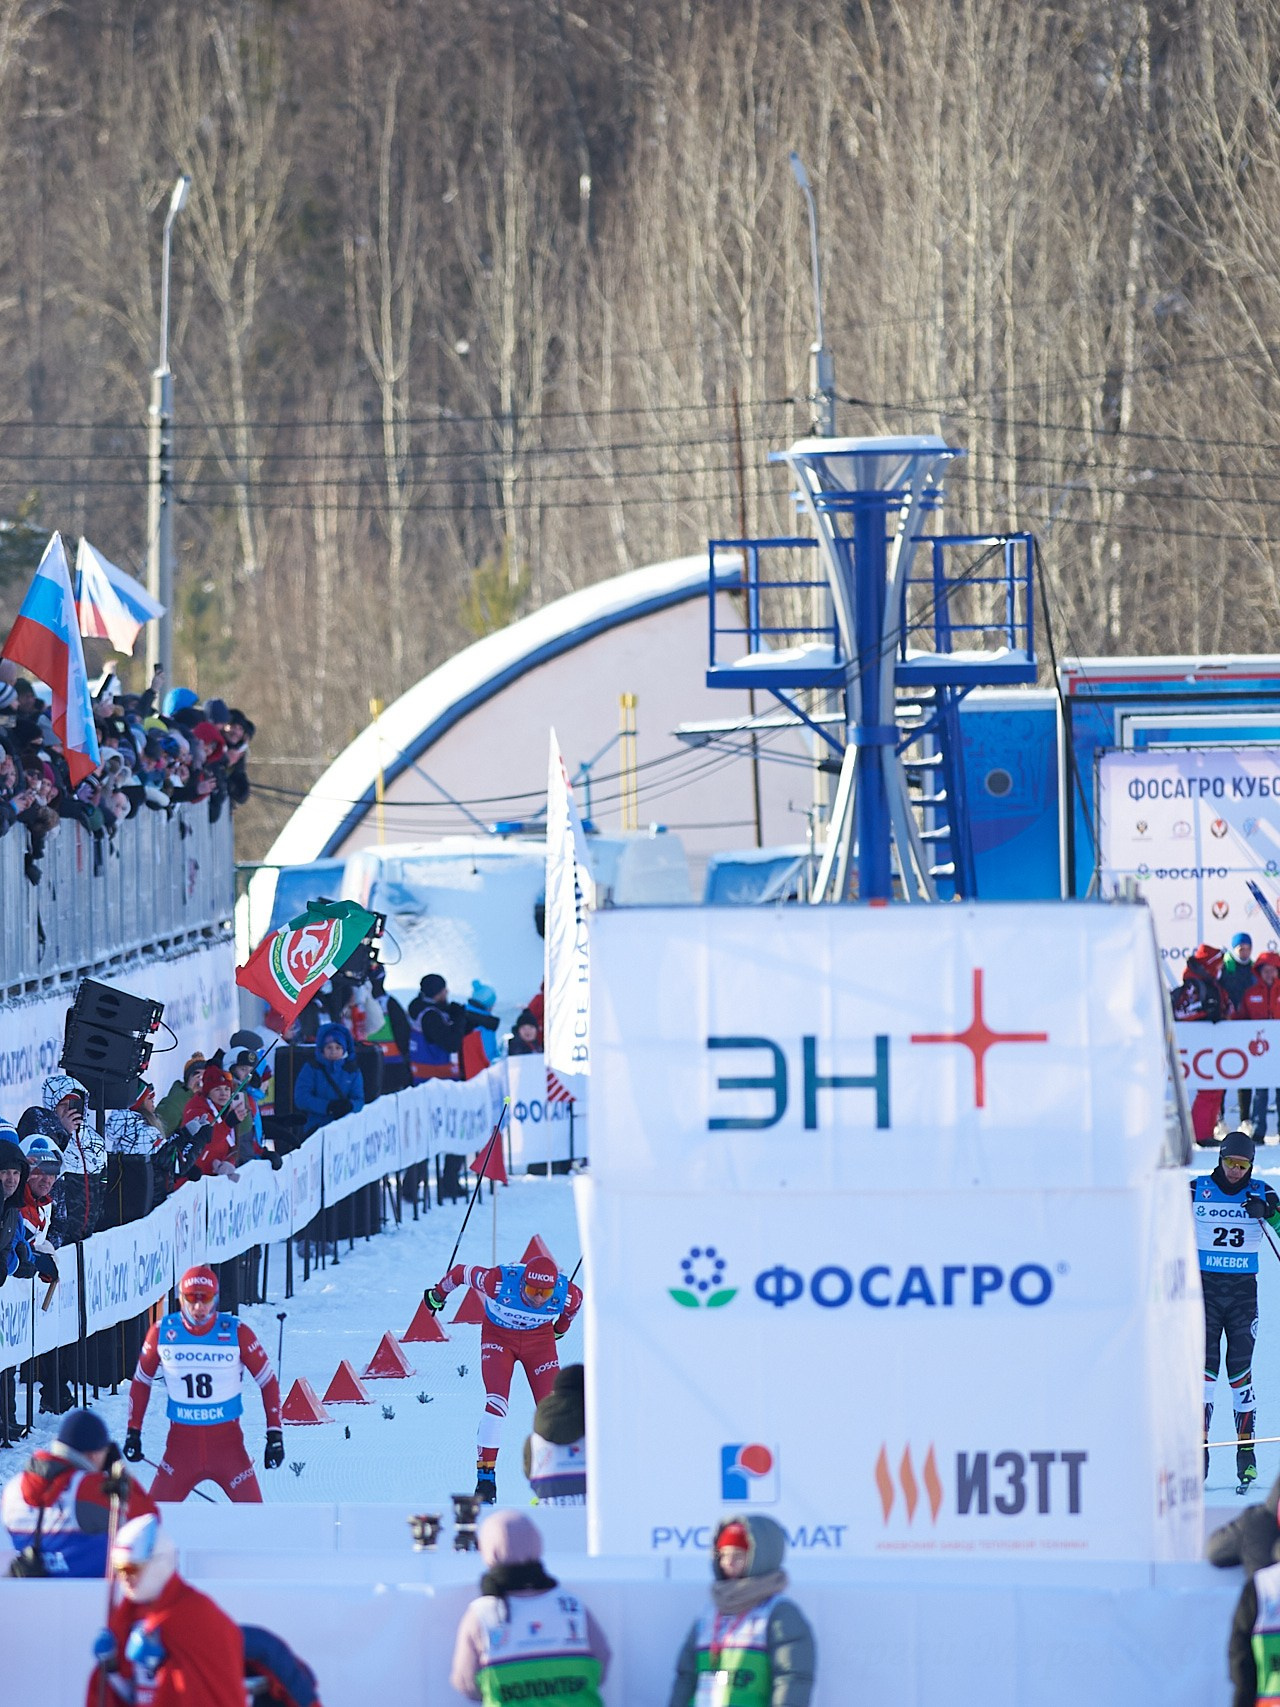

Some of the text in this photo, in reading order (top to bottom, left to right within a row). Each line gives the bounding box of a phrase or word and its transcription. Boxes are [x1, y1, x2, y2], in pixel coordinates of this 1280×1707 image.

[1128, 778, 1225, 801] ФОСАГРО
[1155, 867, 1228, 880] ФОСАГРО
[1209, 1209, 1247, 1219] ФОСАГ
[1213, 1227, 1245, 1248] 23
[1205, 1255, 1249, 1268] ИЖЕВСК
[184, 1276, 214, 1288] LUKOIL
[528, 1271, 555, 1283] LUKOIL
[174, 1351, 234, 1362] ФОСАГРО
[181, 1373, 213, 1399] 18
[176, 1407, 224, 1419] ИЖЕВСК
[956, 1450, 1088, 1515] ИЗТТ
[651, 1525, 847, 1549] РУСМАТ
